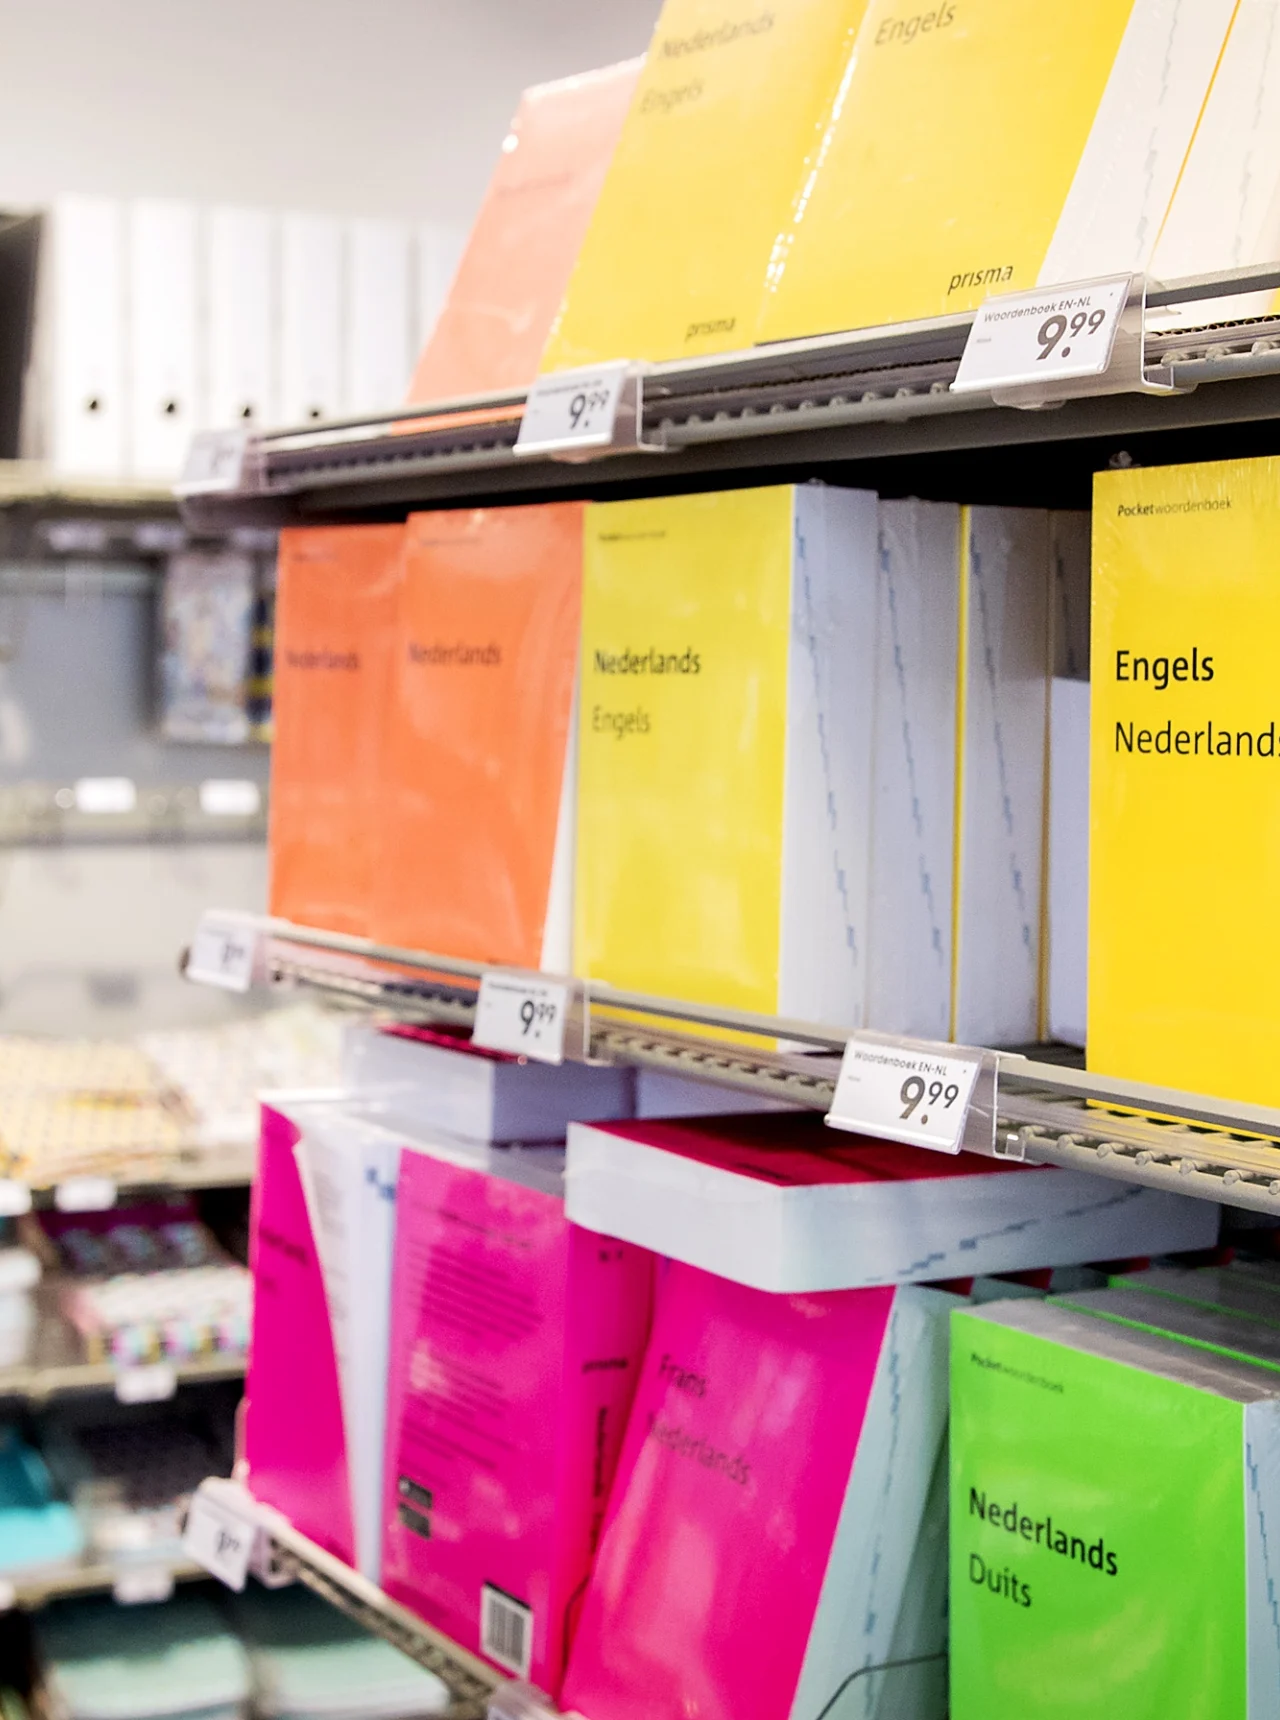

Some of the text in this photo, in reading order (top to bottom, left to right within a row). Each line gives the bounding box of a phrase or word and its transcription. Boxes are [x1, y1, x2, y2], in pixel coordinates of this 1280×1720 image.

[874, 2, 957, 47] Engels
[947, 262, 1014, 295] prisma
[984, 296, 1091, 323] Woordenboek EN-NL
[1117, 497, 1232, 517] Pocketwoordenboek
[594, 648, 701, 676] Nederlands
[1115, 647, 1215, 690] Engels
[592, 705, 650, 739] Engels
[854, 1050, 948, 1077] Woordenboek EN-NL
[970, 1488, 1118, 1576] Nederlands
[970, 1553, 1033, 1608] Duits
